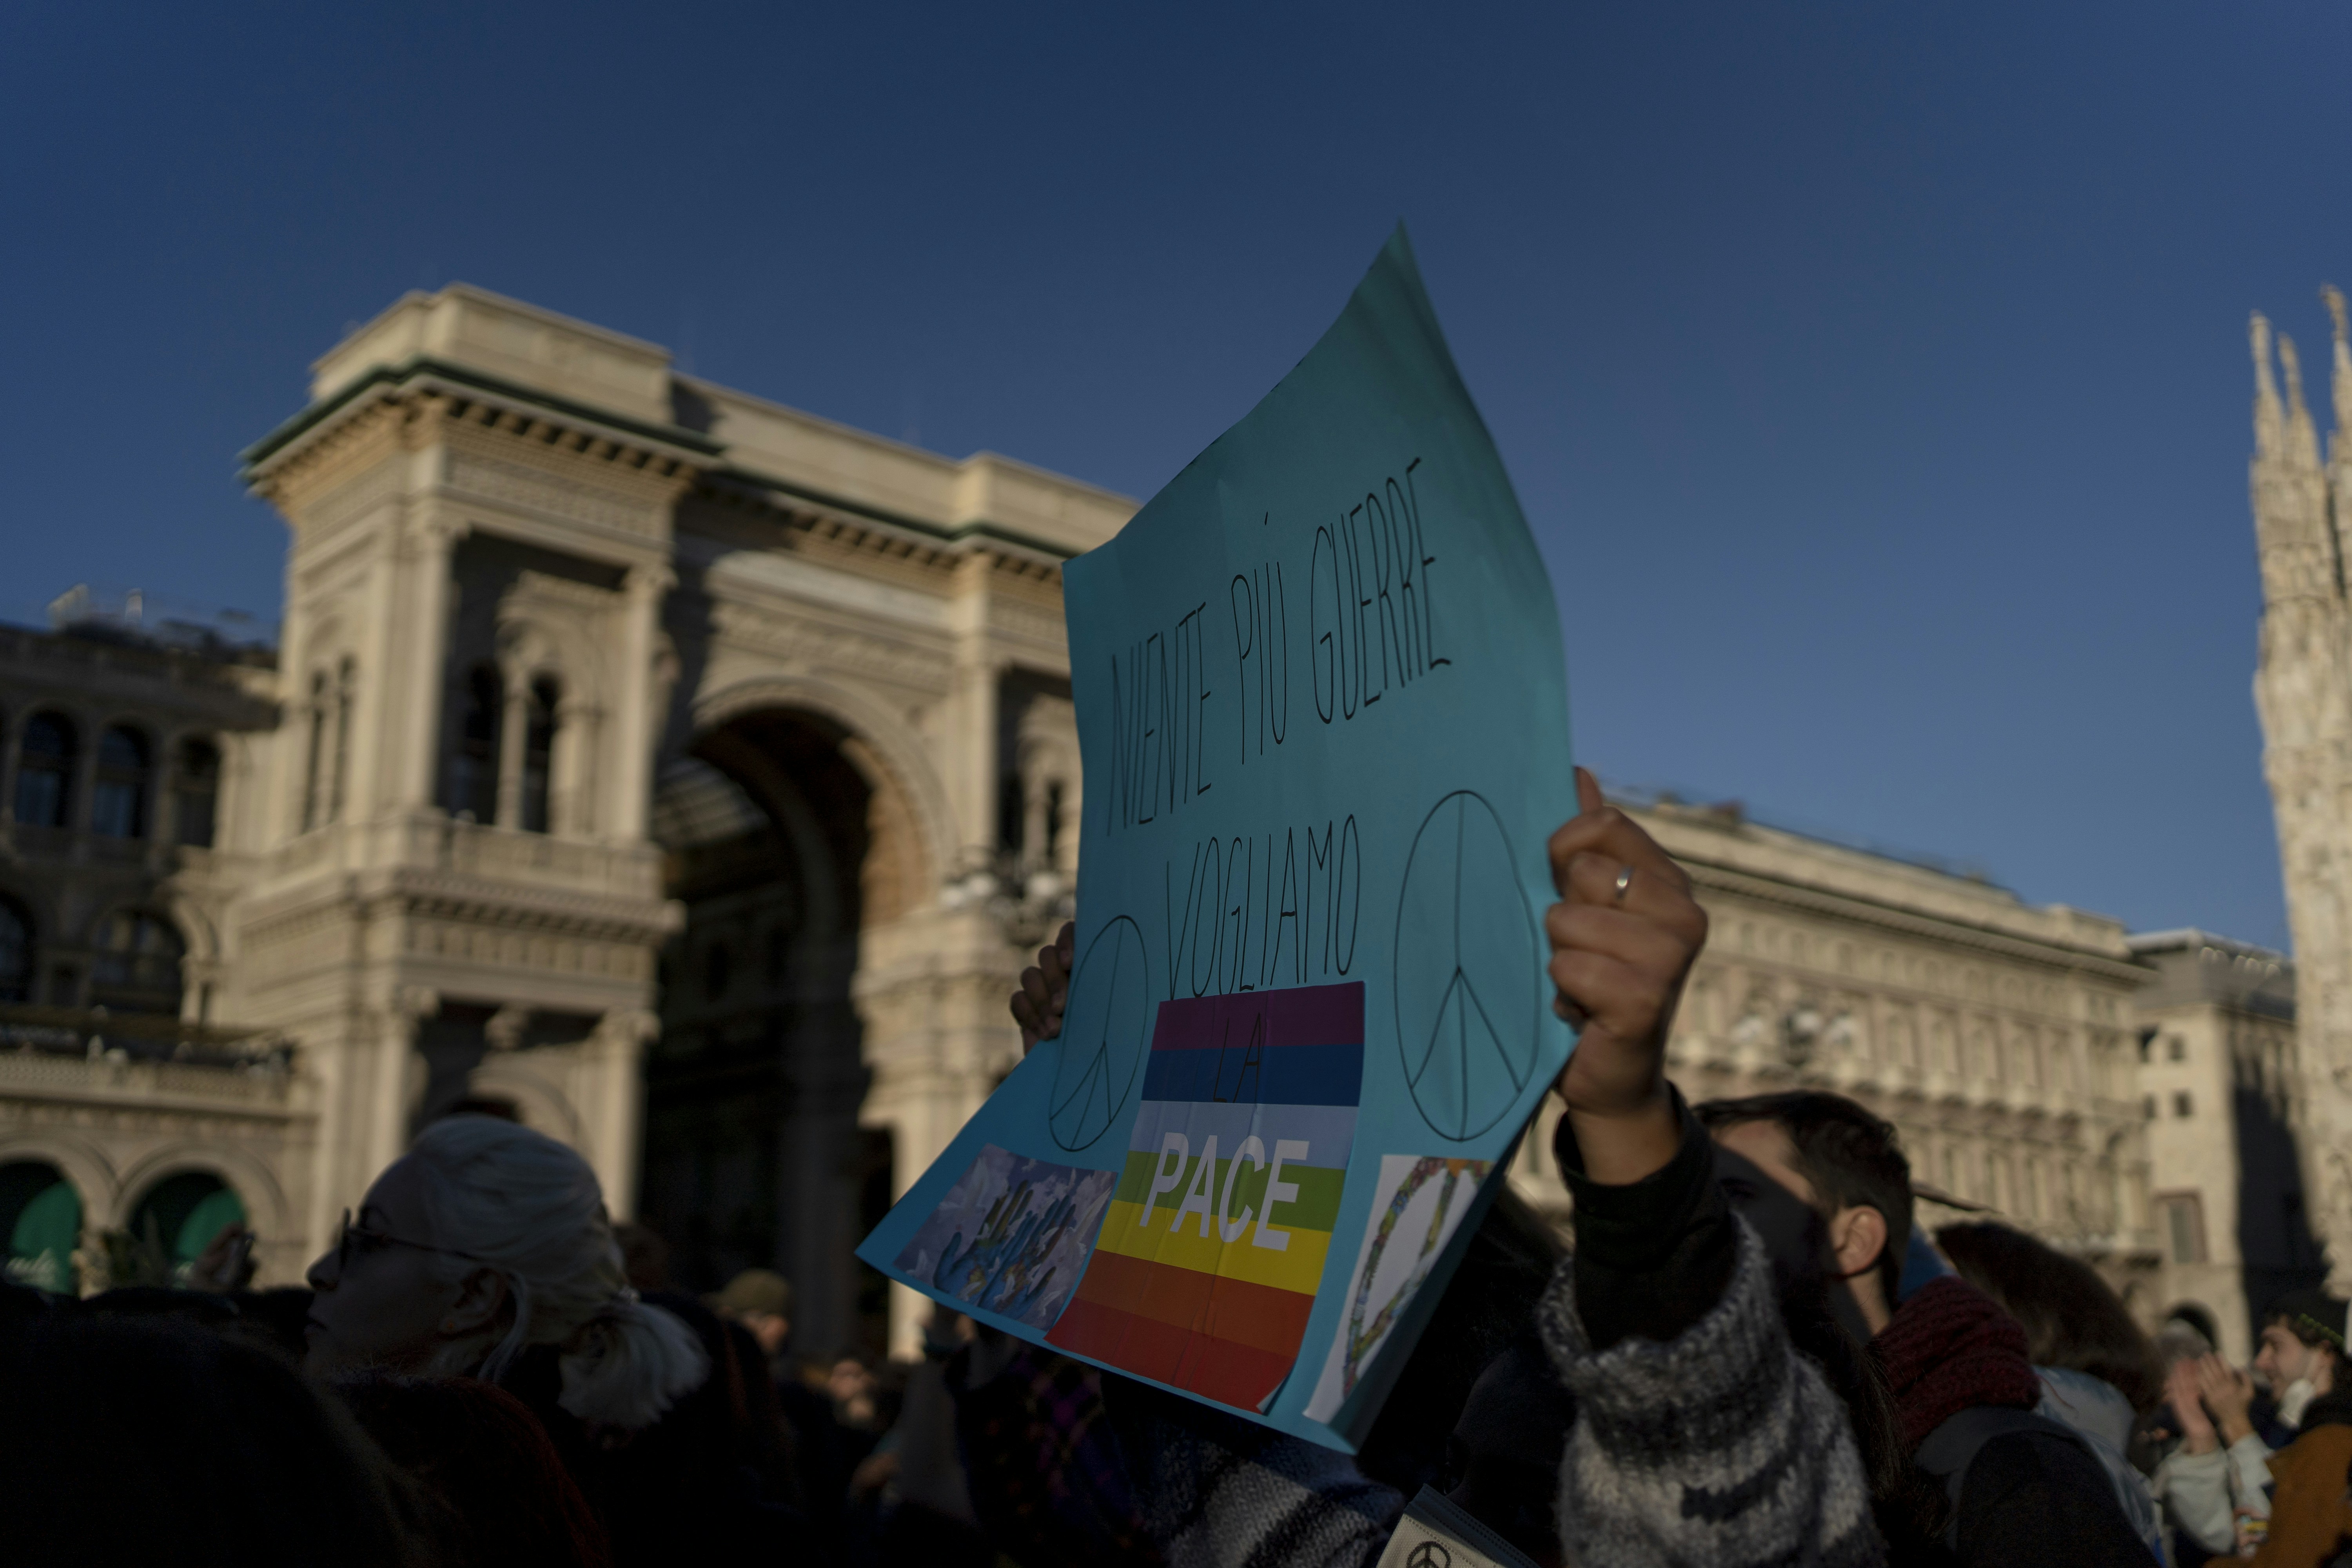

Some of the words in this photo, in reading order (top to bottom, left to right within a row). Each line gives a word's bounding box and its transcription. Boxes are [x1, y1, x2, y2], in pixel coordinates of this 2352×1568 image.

[1107, 601, 1212, 837] NIENTE
[1310, 457, 1452, 724] GUERRE
[1167, 813, 1360, 1000] VOGLIAMO
[1213, 1012, 1261, 1103] LA
[1139, 1132, 1310, 1252] PACE
